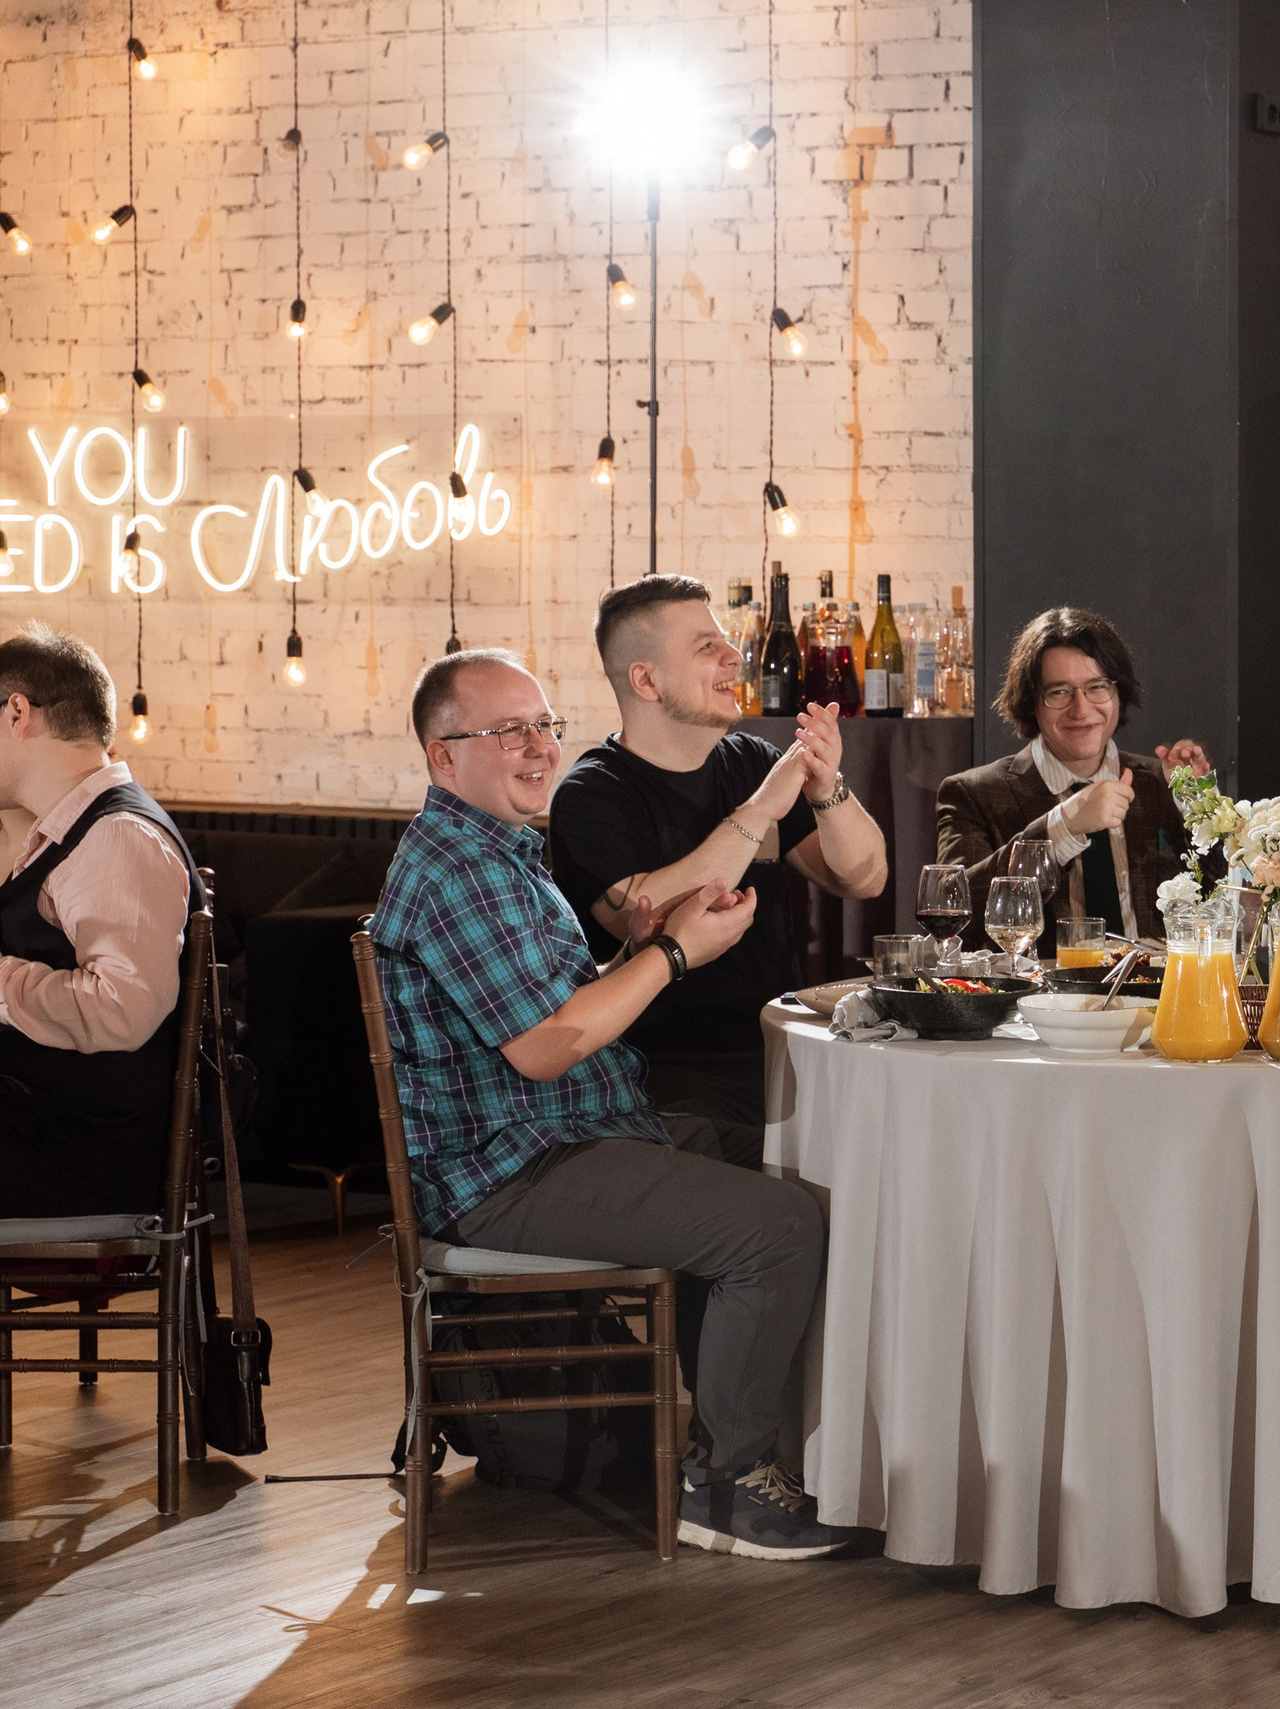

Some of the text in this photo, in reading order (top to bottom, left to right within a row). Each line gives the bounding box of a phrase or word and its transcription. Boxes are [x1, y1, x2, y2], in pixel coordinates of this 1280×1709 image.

[27, 426, 190, 506] YOU
[190, 423, 512, 593] Любовь
[110, 513, 167, 594] IS
